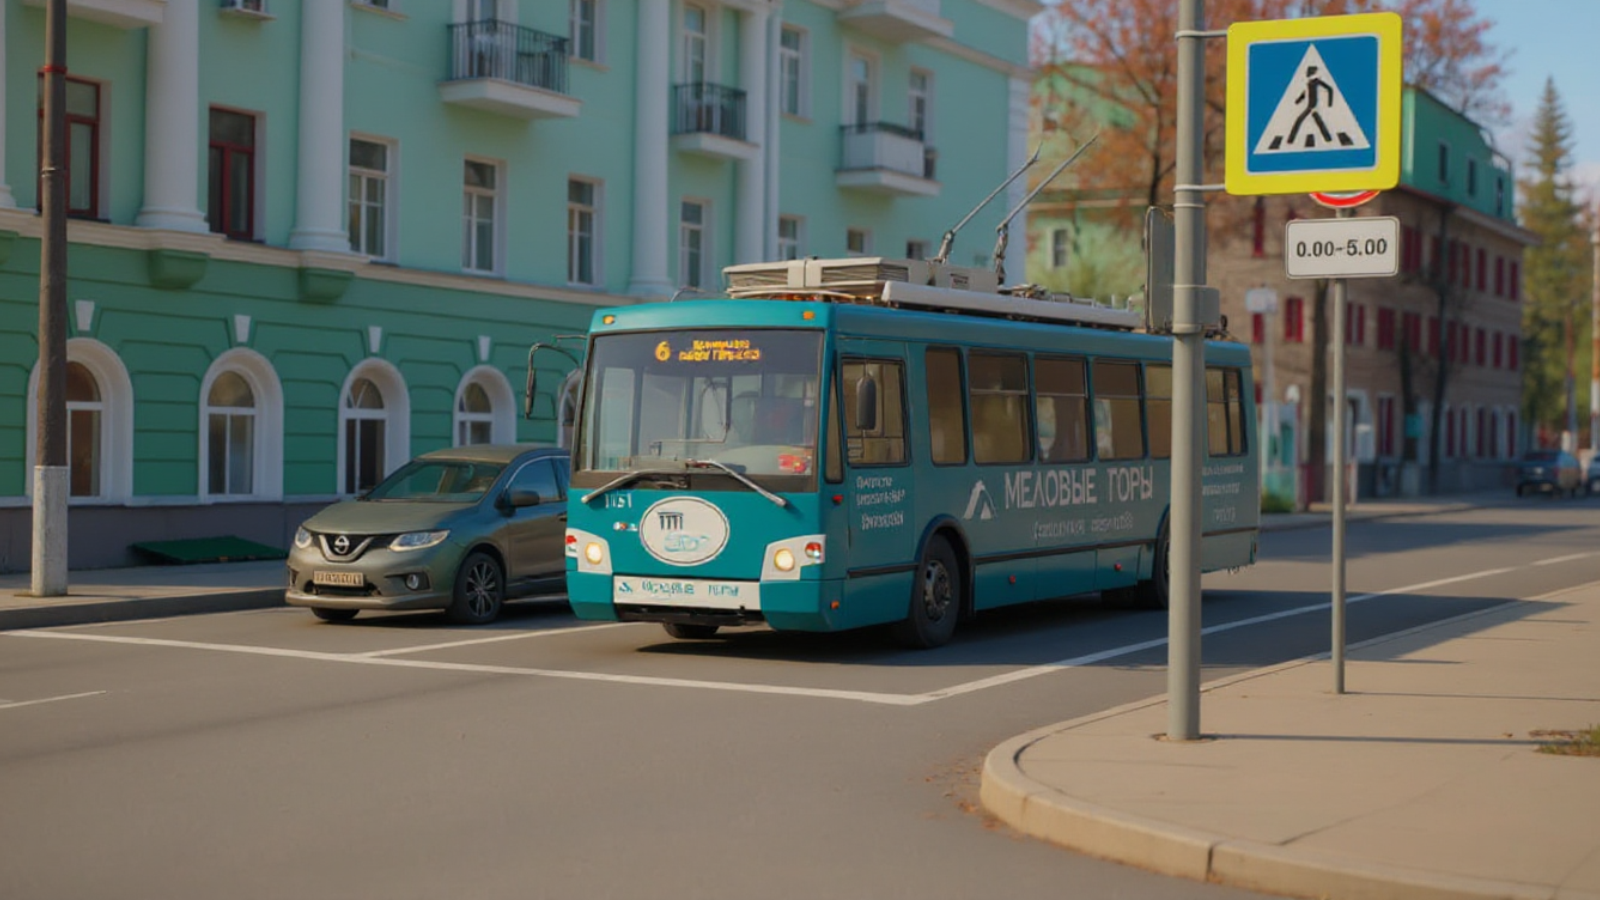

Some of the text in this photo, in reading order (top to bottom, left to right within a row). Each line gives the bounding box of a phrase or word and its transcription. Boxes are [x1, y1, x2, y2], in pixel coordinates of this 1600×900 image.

[1296, 238, 1388, 258] 0.00-5.00
[655, 340, 671, 361] 6
[1004, 468, 1098, 509] МЕЛОВЫЕ
